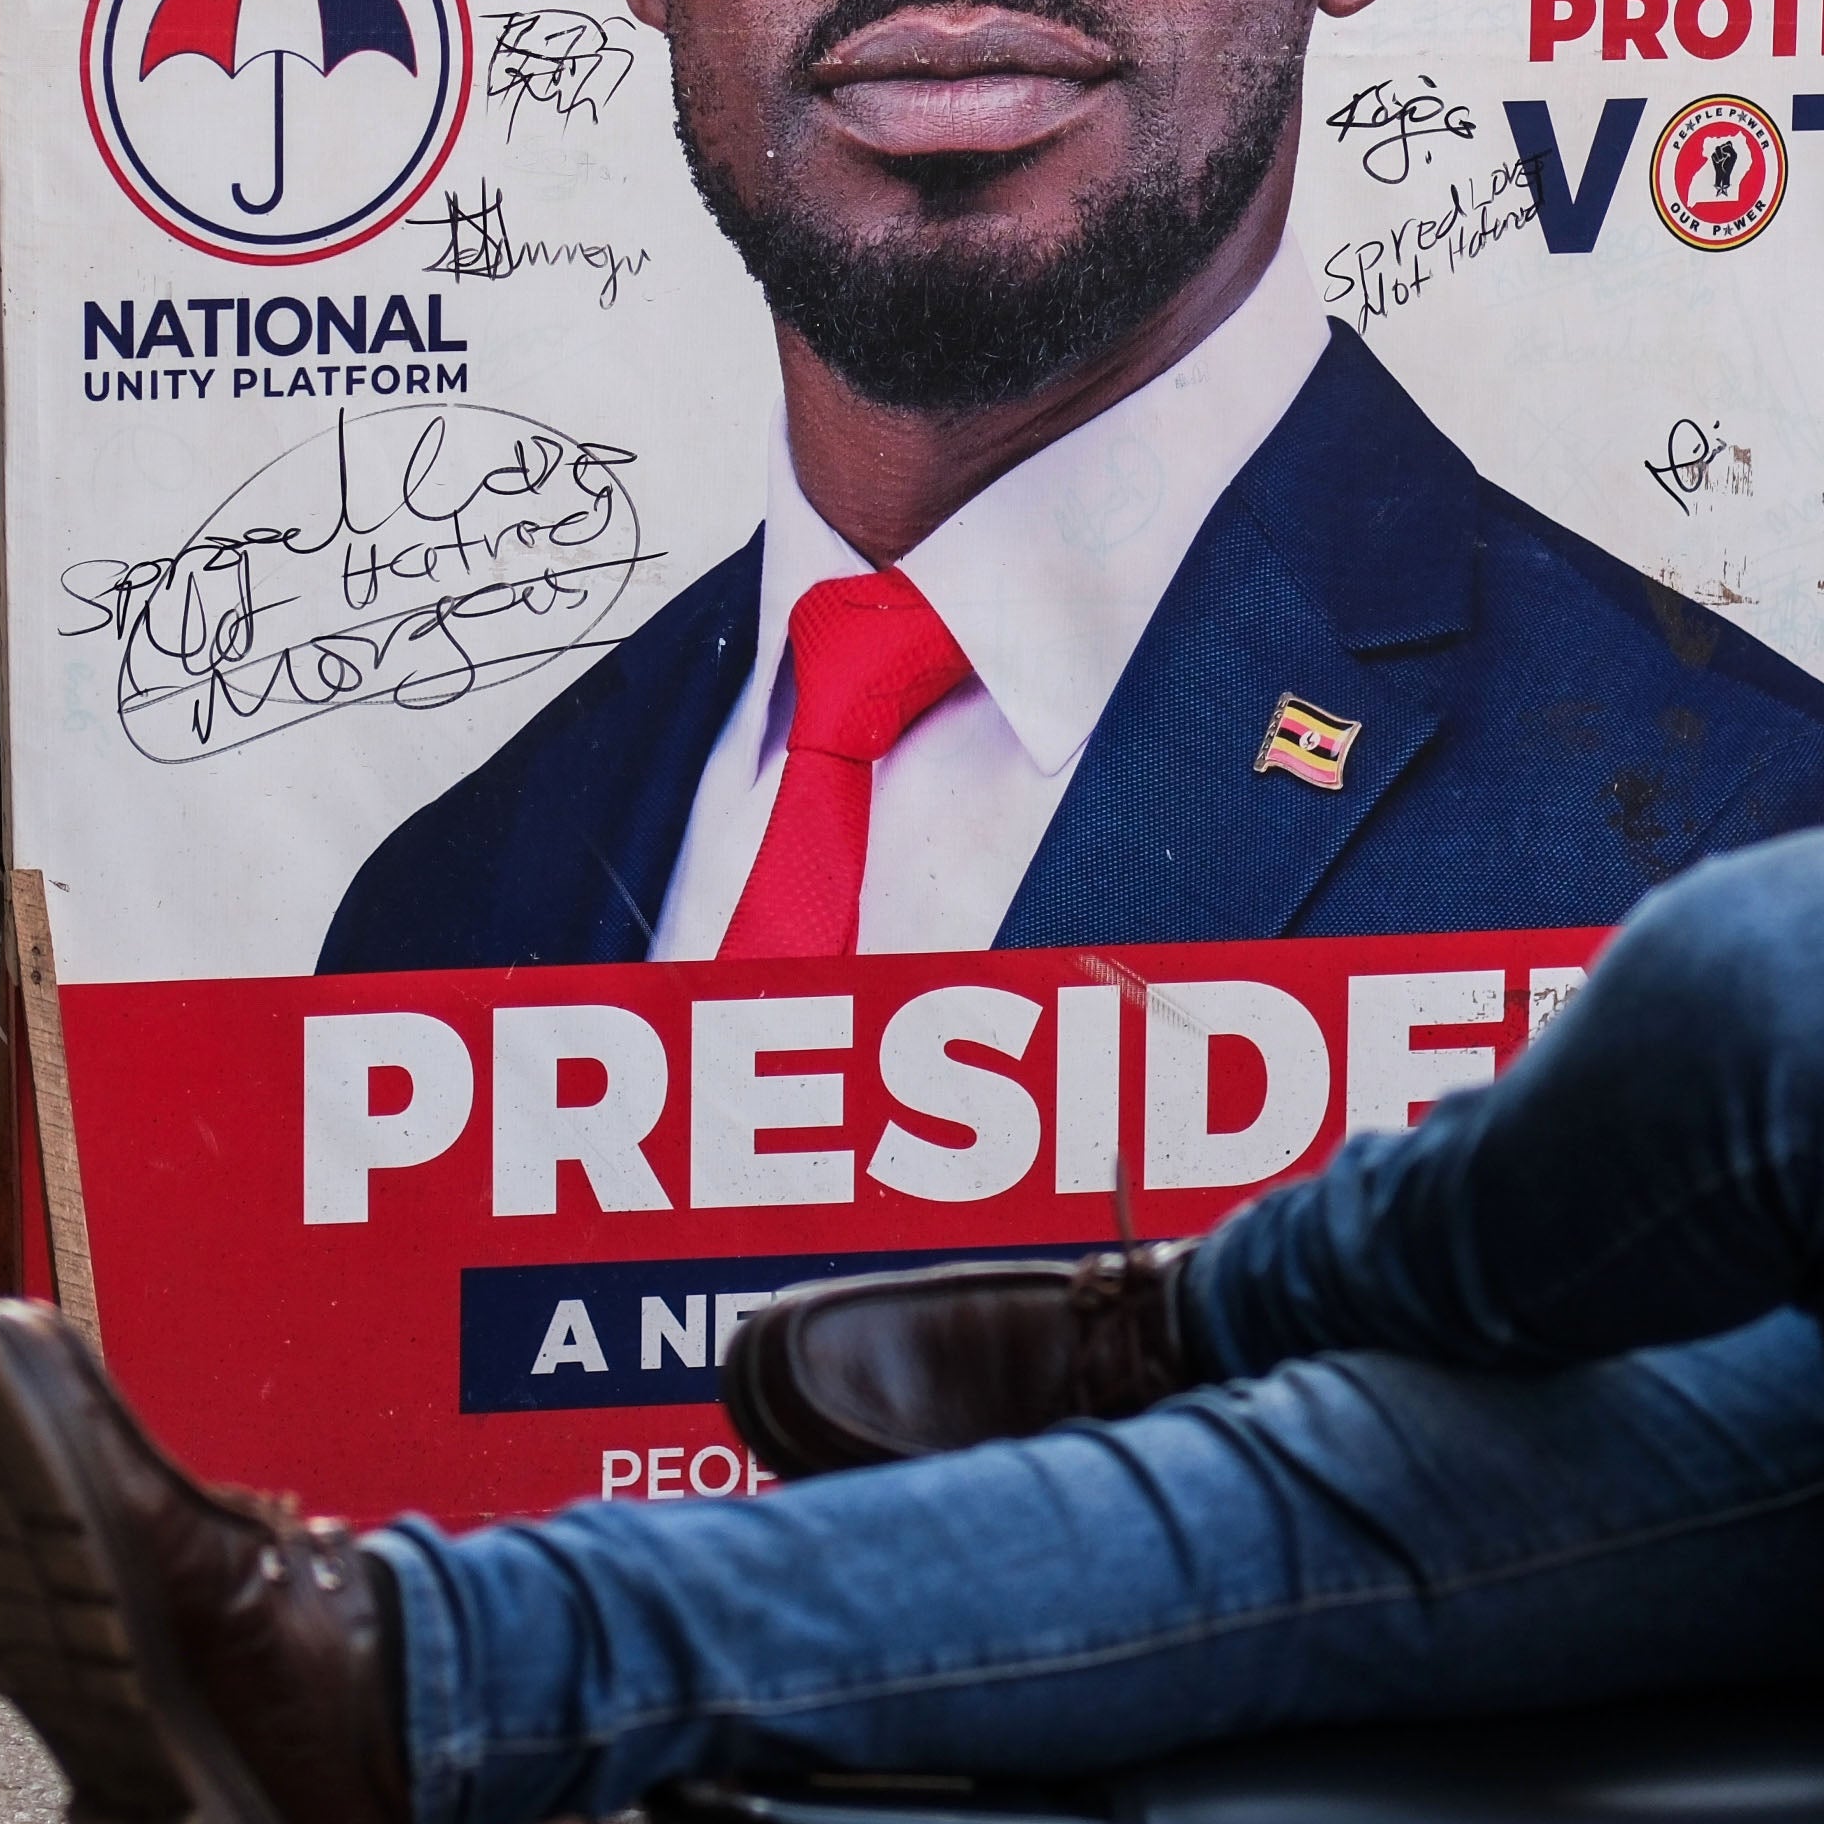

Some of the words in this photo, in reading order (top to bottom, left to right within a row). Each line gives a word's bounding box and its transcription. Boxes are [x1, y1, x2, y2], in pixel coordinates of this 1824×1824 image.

[1672, 107, 1723, 151] PEPLE
[1728, 108, 1770, 151] PWER
[1670, 202, 1701, 233] OUR
[1712, 199, 1767, 237] PWER
[82, 292, 468, 360] NATIONAL
[84, 367, 216, 402] UNITY
[232, 362, 469, 398] PLATFORM
[530, 1298, 610, 1375] A
